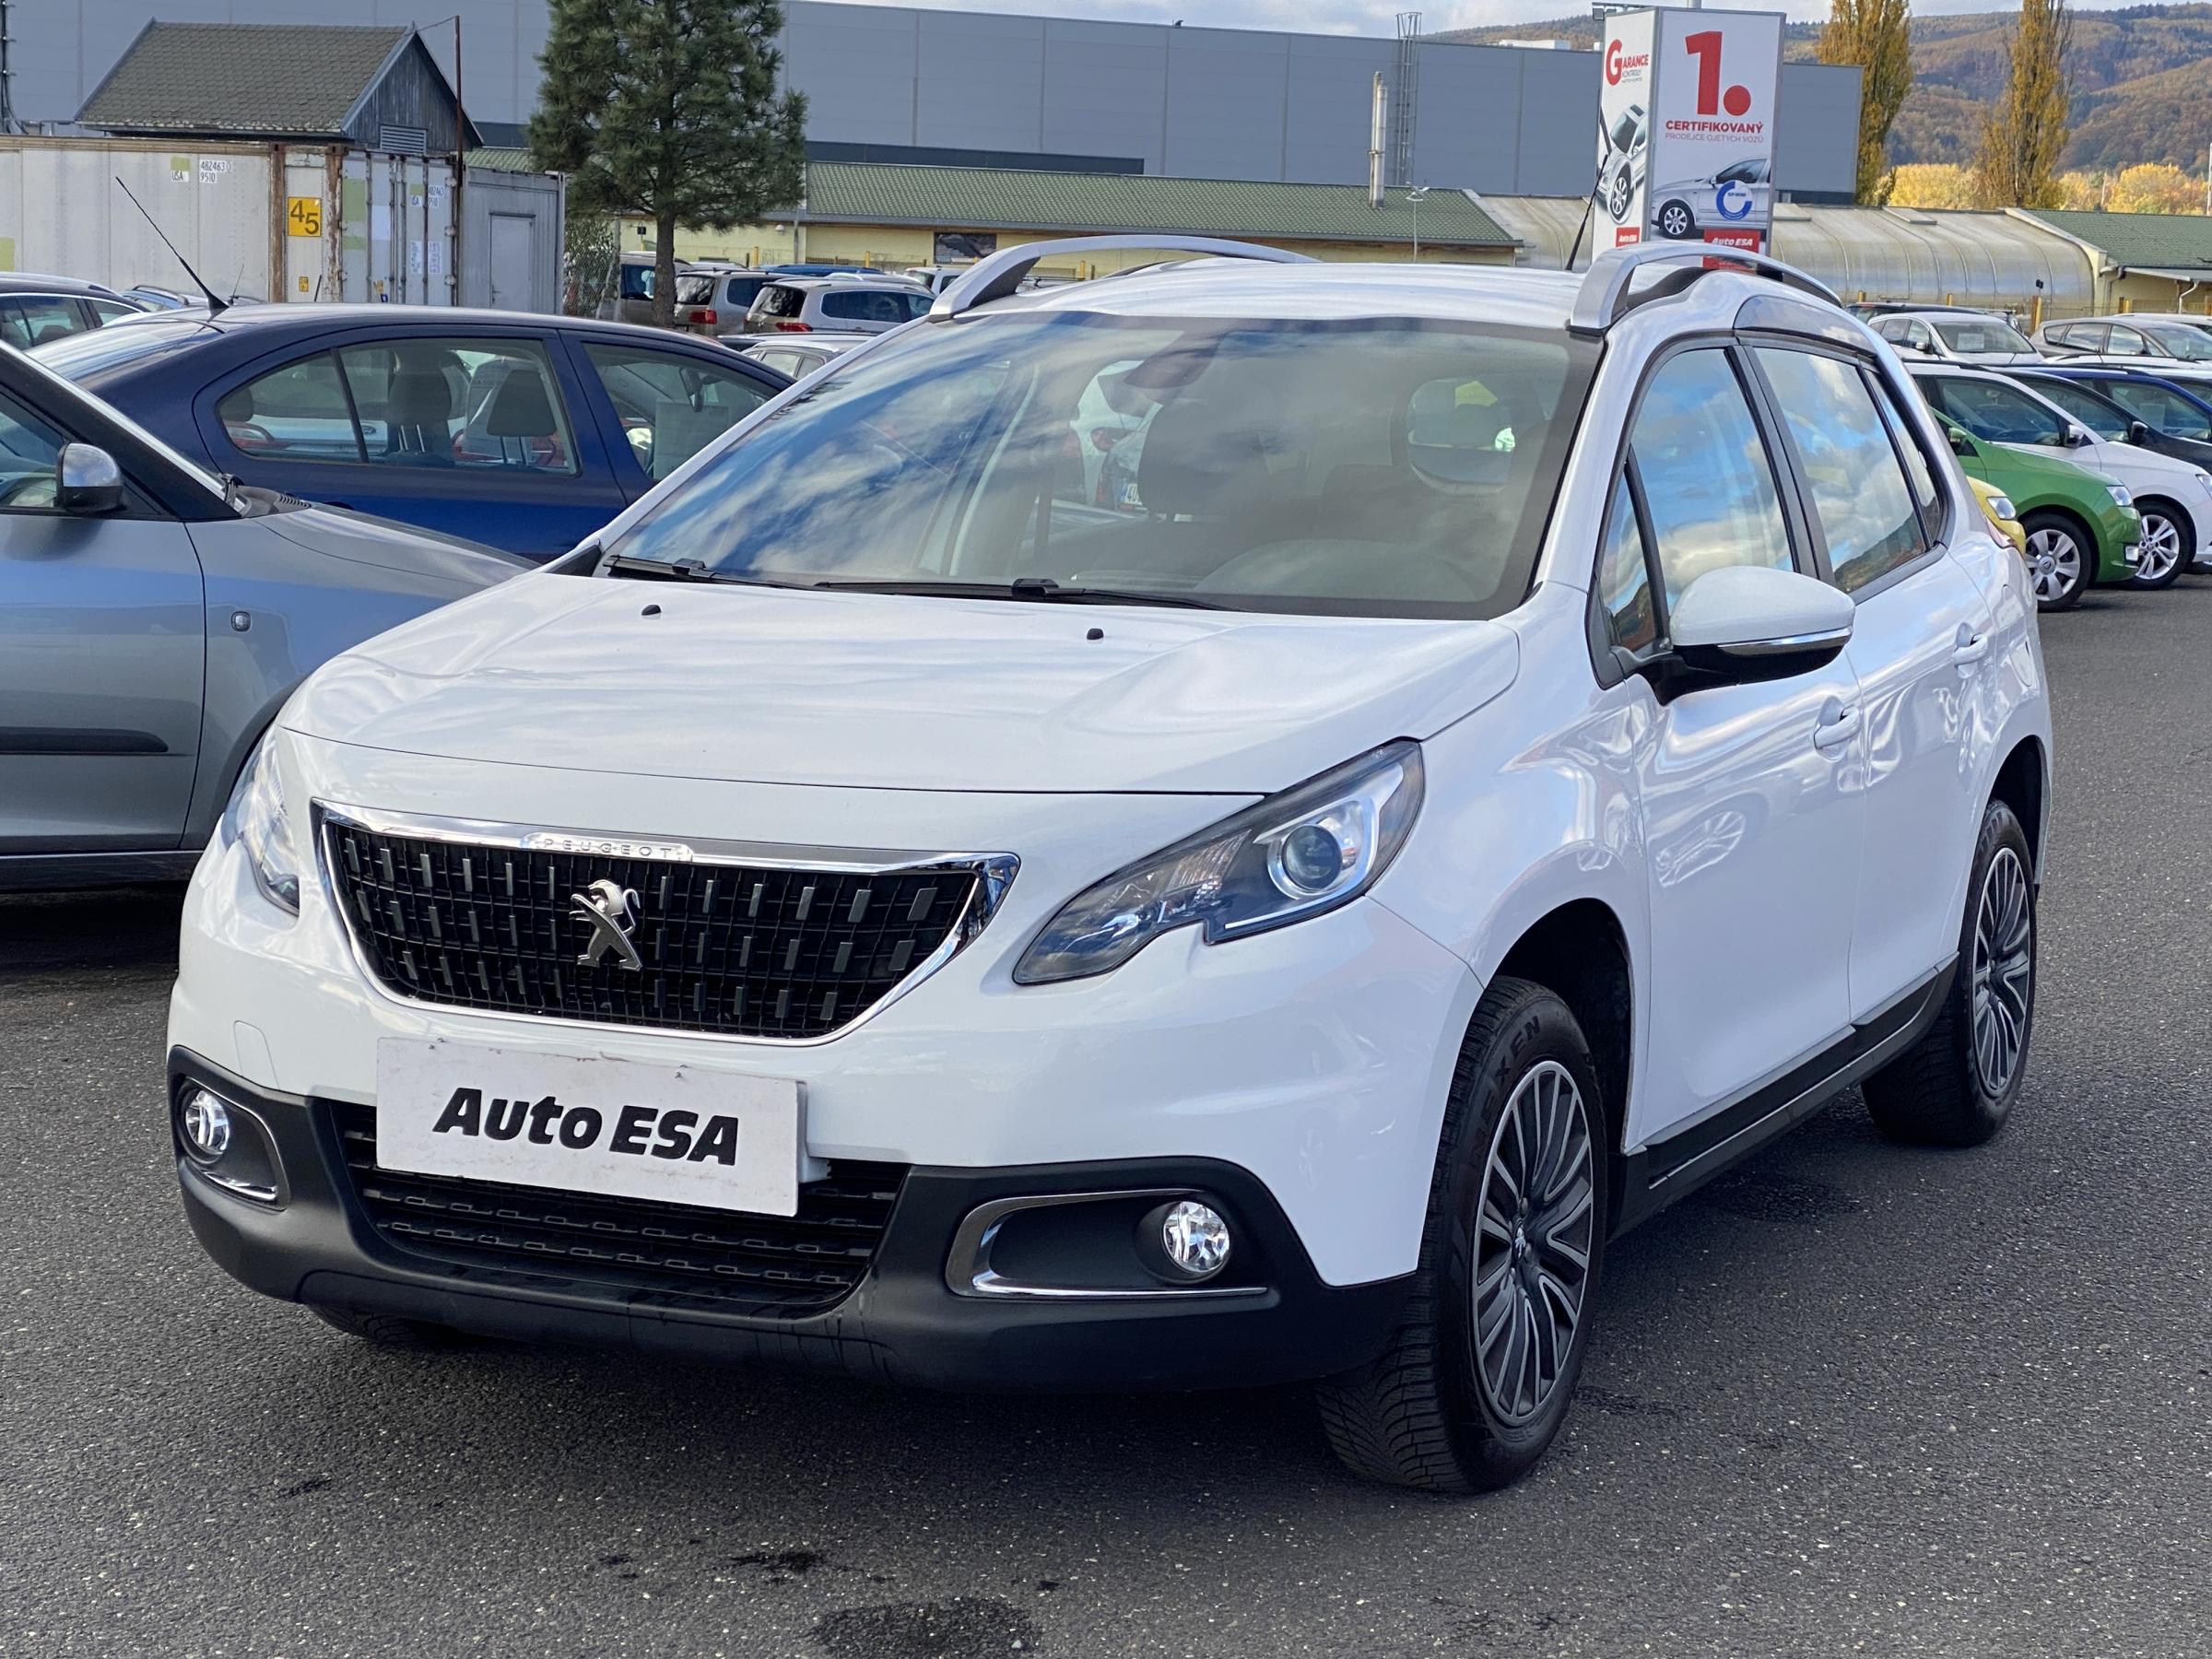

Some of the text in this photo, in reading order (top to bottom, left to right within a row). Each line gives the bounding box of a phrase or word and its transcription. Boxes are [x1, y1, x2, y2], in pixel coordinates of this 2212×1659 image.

[1606, 39, 1649, 86] GARANCE
[1685, 30, 1752, 116] 1.
[1665, 121, 1763, 134] CERTIFIKOVANÝ
[1665, 133, 1705, 141] PRODEJCE
[289, 200, 320, 234] 45
[1712, 237, 1753, 246] Auto ESA
[544, 839, 672, 859] PEUGEOT
[432, 1087, 739, 1166] Auto ESA
